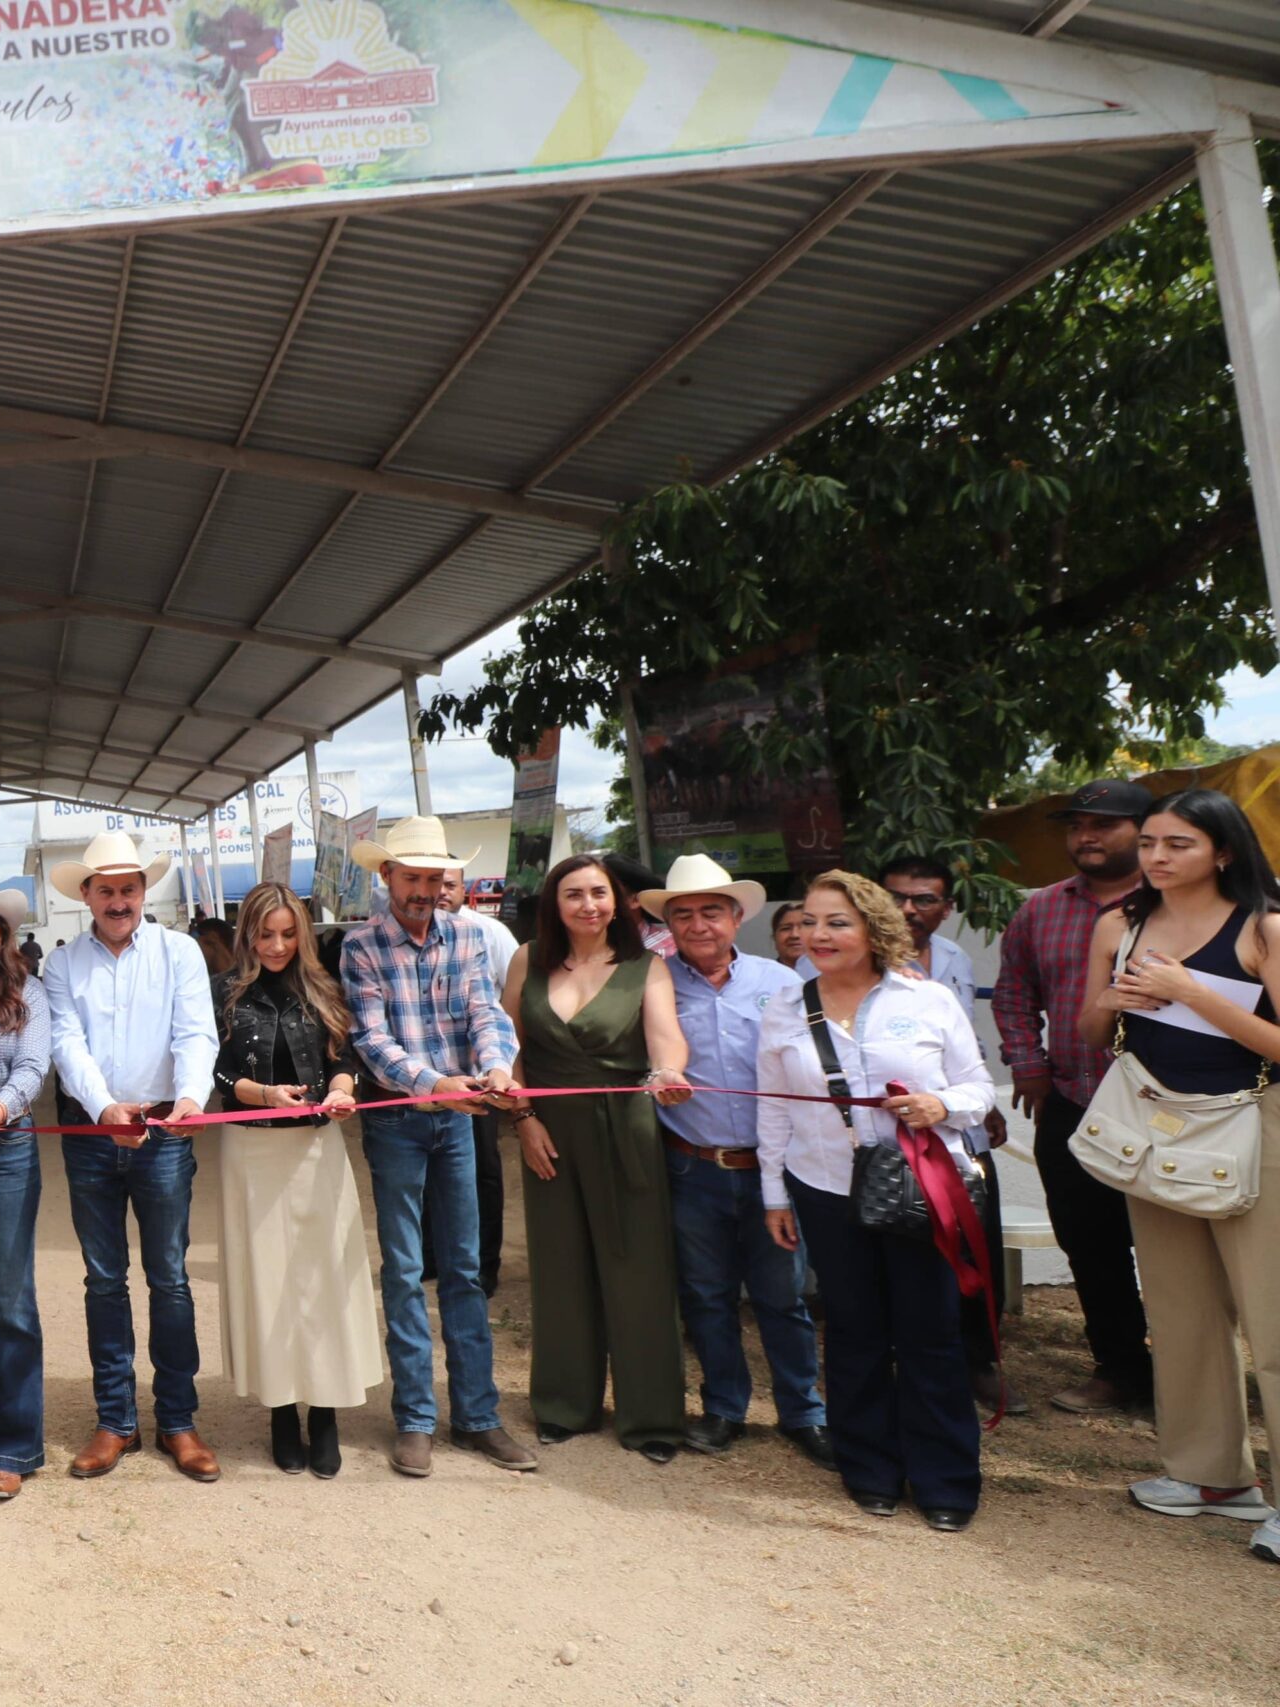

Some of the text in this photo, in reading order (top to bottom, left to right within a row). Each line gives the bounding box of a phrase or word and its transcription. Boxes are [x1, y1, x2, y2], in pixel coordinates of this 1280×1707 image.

[2, 41, 22, 61] A
[31, 27, 170, 59] NUESTRO
[284, 111, 408, 133] Ayuntamiento de
[266, 126, 429, 153] VILLAFLORES
[106, 815, 124, 830] DE
